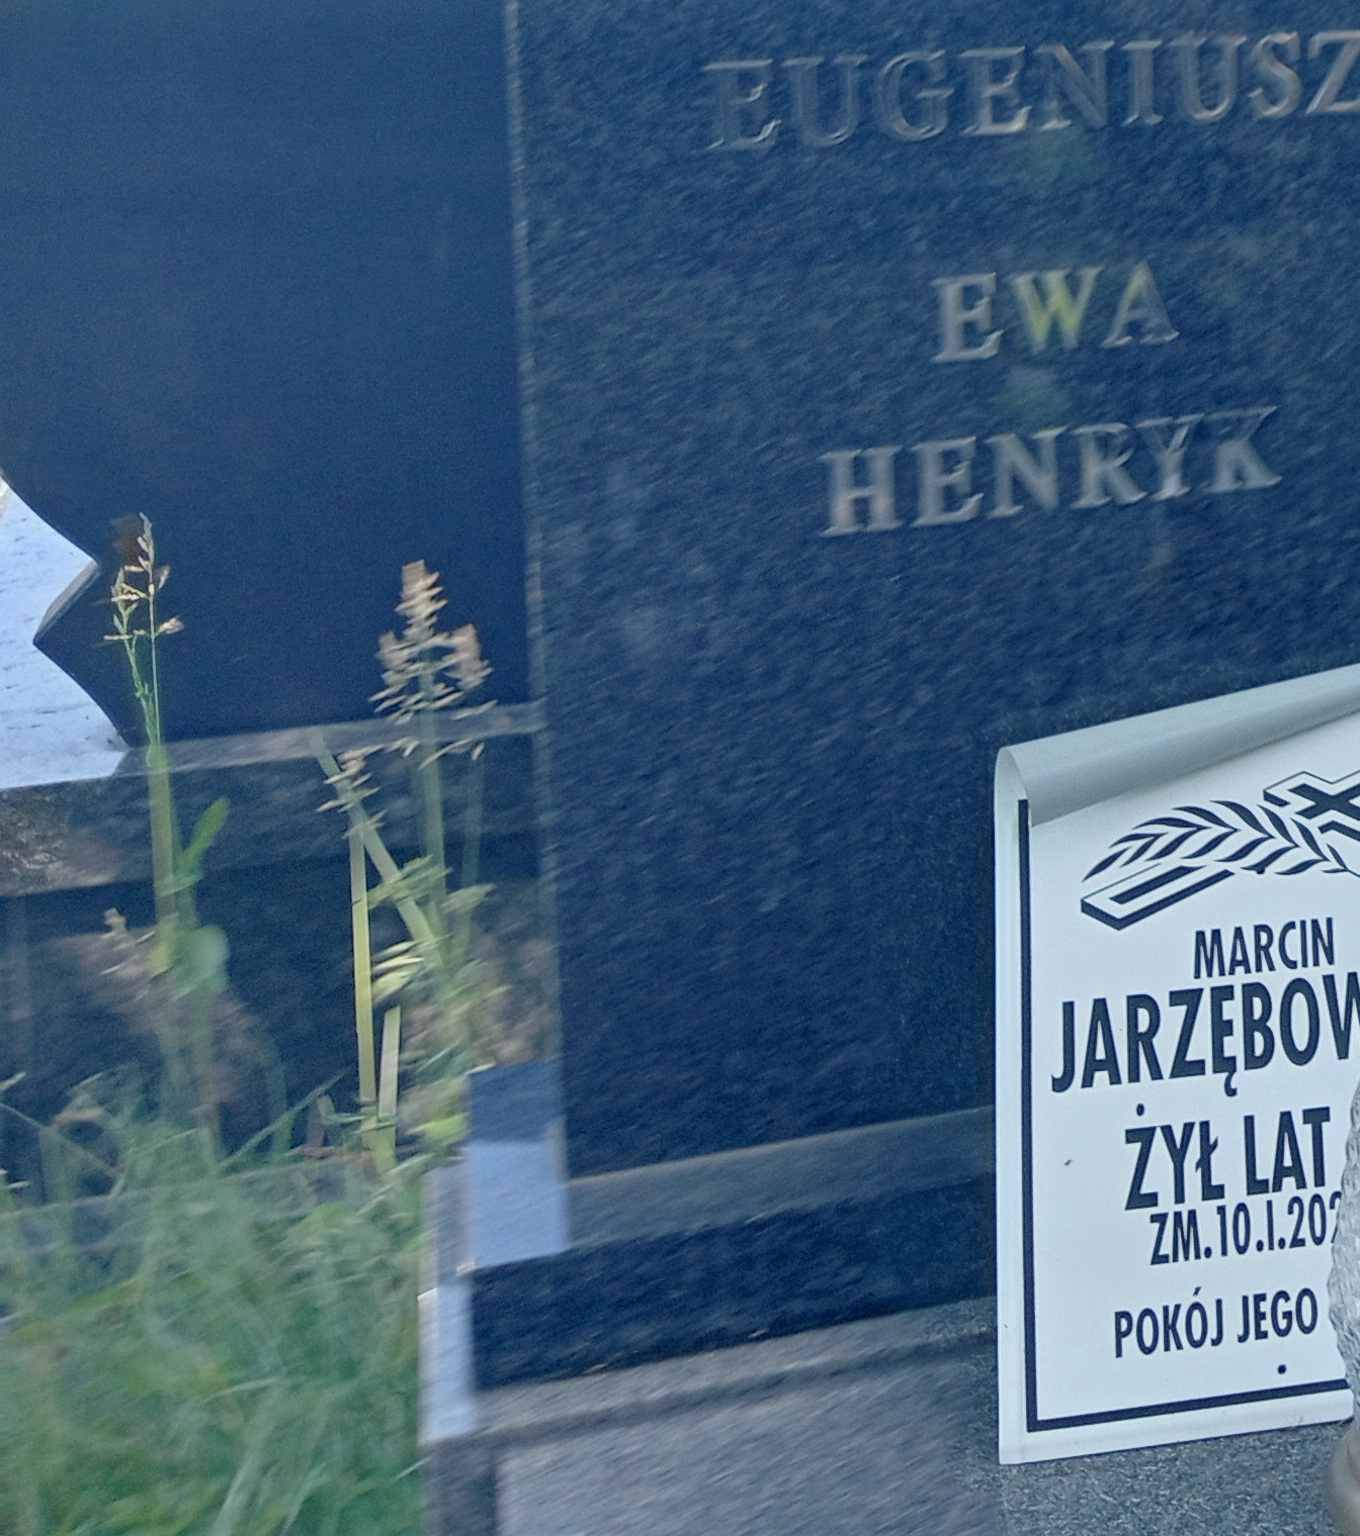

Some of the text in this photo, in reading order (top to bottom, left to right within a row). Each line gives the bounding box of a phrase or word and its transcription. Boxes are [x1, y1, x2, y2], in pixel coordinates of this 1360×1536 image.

[930, 260, 1180, 363] EWA
[819, 404, 1283, 538] HENRYK
[1192, 916, 1336, 980] MARCIN
[1124, 1102, 1332, 1212] ŻYŁ LAT
[1113, 1286, 1319, 1359] POKÓJ JEGO
